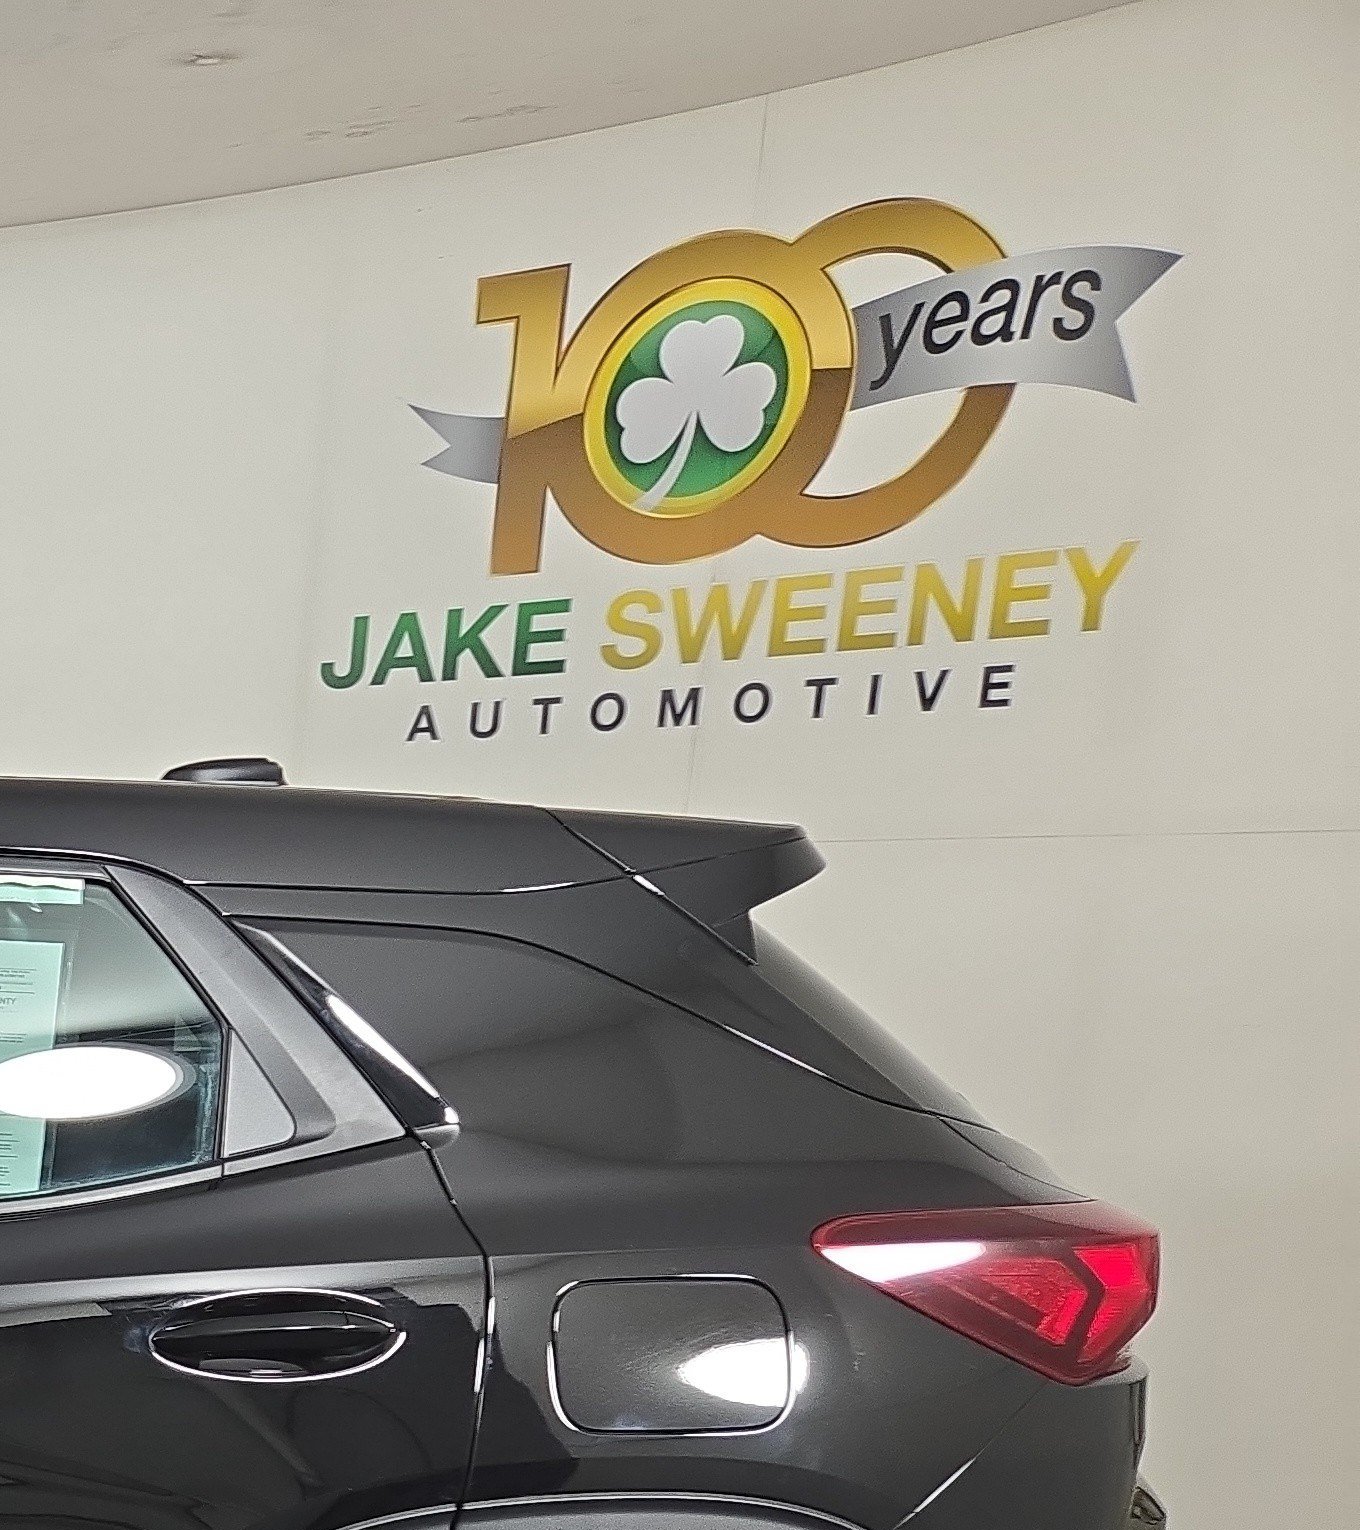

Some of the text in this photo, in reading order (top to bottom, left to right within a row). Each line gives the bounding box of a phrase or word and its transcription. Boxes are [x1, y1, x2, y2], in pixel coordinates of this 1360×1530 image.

[870, 268, 1101, 391] years
[320, 541, 1141, 690] JAKE SWEENEY
[407, 665, 1017, 742] AUTOMOTIVE
